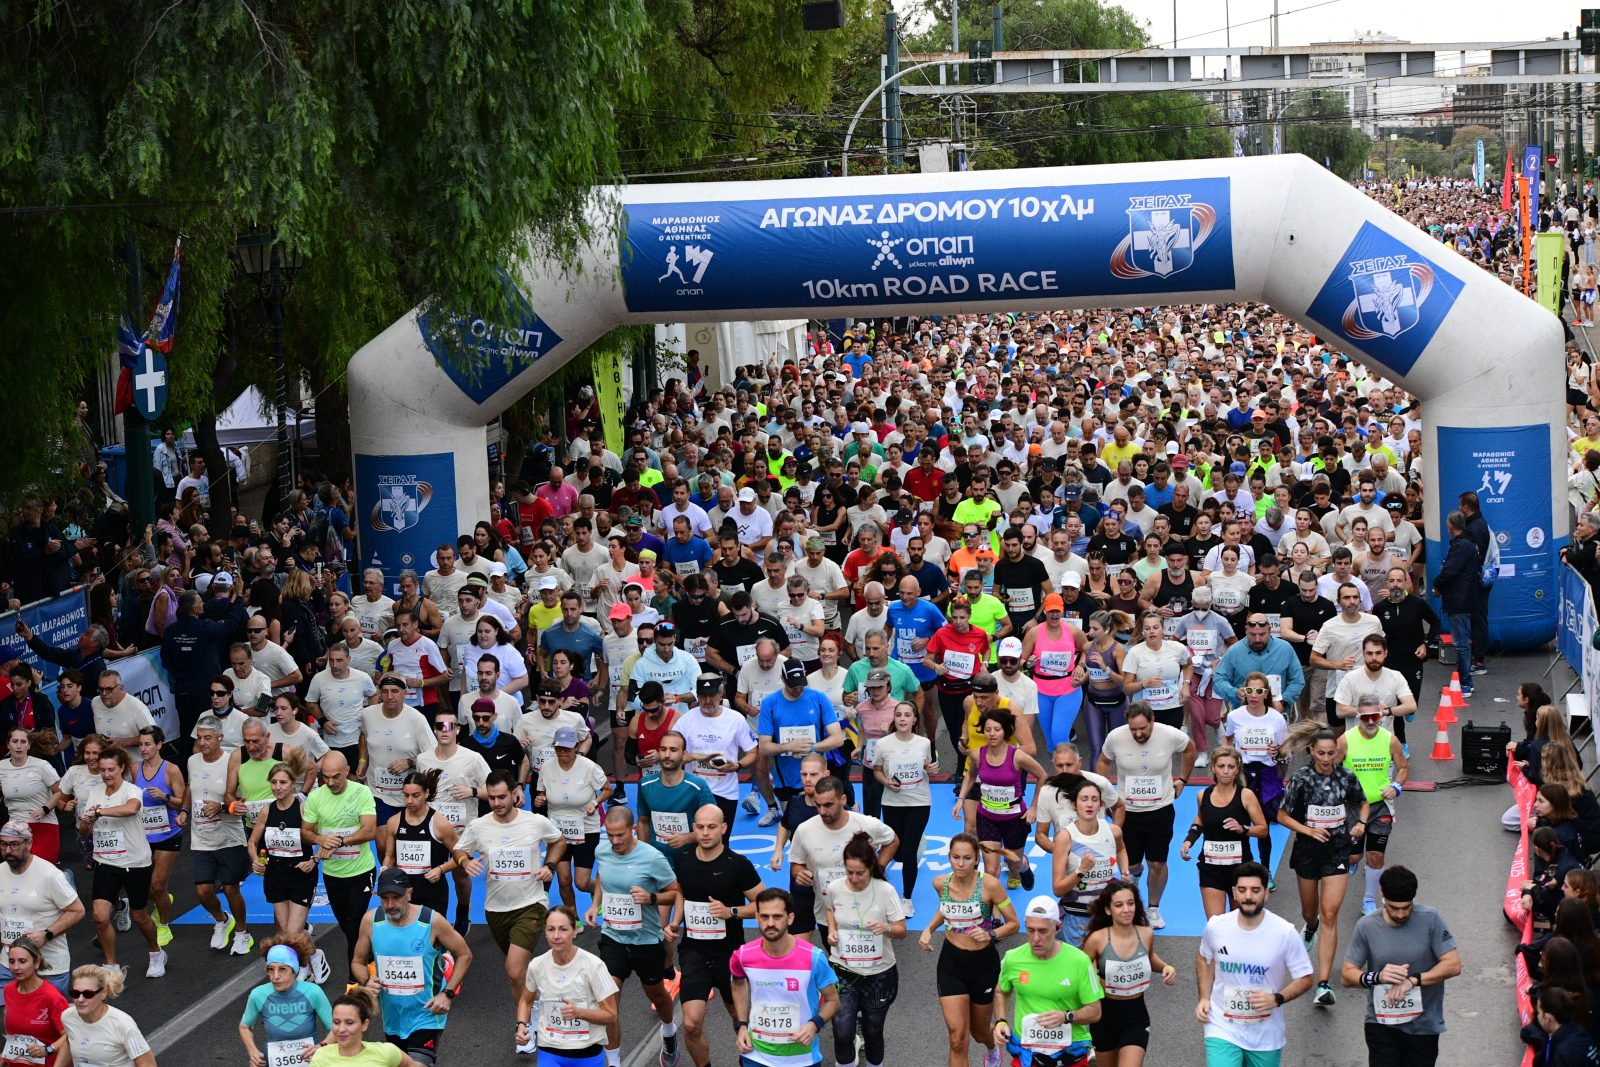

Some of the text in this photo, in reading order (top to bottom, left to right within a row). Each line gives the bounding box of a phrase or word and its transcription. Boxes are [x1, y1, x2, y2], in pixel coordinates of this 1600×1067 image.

[1529, 156, 1536, 169] 2
[1129, 194, 1191, 209] ΣΕΓΑΣ
[760, 194, 1094, 228] ΑΓΩΝΑΣ ΔΡΟΜΟΥ 10χλμ
[652, 215, 721, 225] ΜΑΡΑΘΩΝΙΟΣ
[664, 224, 707, 234] ΑΘΗΝΑΣ
[665, 233, 712, 241] ΑΥΘΕΝΤΙΚΟΣ
[938, 255, 975, 268] allwyn
[1350, 255, 1408, 276] ΣΕΓΑΣ
[802, 270, 1059, 300] 10km ROAD RACE
[500, 345, 539, 360] allwyn
[379, 474, 417, 485] ΣΕΓΑΣ
[41, 607, 85, 633] ΜΑΡΑΘΩΝΙΟΣ
[52, 624, 78, 644] ΑΘΗΝΑΣ
[649, 670, 684, 678] SYNDICATE
[1131, 787, 1157, 795] 36640
[1314, 807, 1341, 816] 35920
[96, 839, 119, 848] 35487
[270, 838, 295, 848] 36102
[1209, 843, 1235, 852] 35919
[400, 853, 425, 862] 35407
[495, 859, 525, 869] 35796
[1084, 868, 1113, 879] 36699
[607, 906, 635, 916] 35476
[945, 904, 973, 914] 35784
[689, 915, 719, 925] 36405
[845, 944, 876, 953] 36884
[1219, 960, 1270, 976] RUNWAY
[384, 970, 417, 980] 35444
[1113, 971, 1144, 984] 36308
[267, 1000, 308, 1015] arena
[757, 1016, 792, 1029] 36178
[1029, 1029, 1064, 1041] 36098
[275, 1053, 307, 1067] 3569
